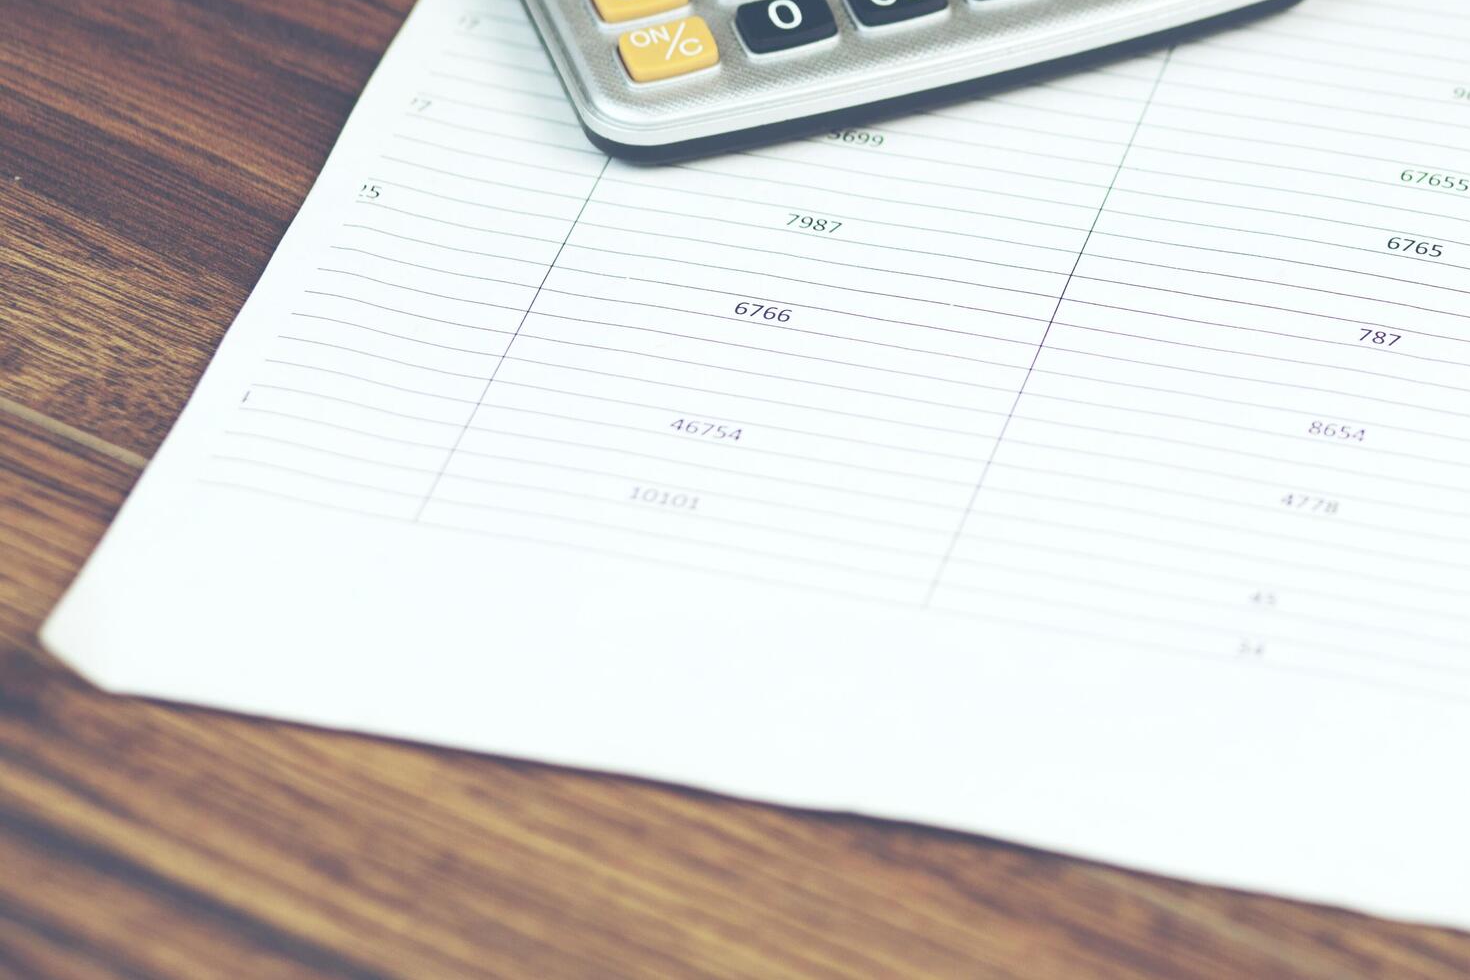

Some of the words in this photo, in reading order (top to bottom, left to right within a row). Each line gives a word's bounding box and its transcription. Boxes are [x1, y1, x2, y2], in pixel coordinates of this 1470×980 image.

[1400, 169, 1470, 192] 67655
[785, 213, 842, 234] 7987
[1387, 236, 1444, 258] 6765
[734, 301, 792, 322] 6766
[1358, 327, 1401, 347] 787
[669, 417, 743, 441] 46754
[1308, 420, 1366, 442] 8654
[628, 485, 699, 510] 10101
